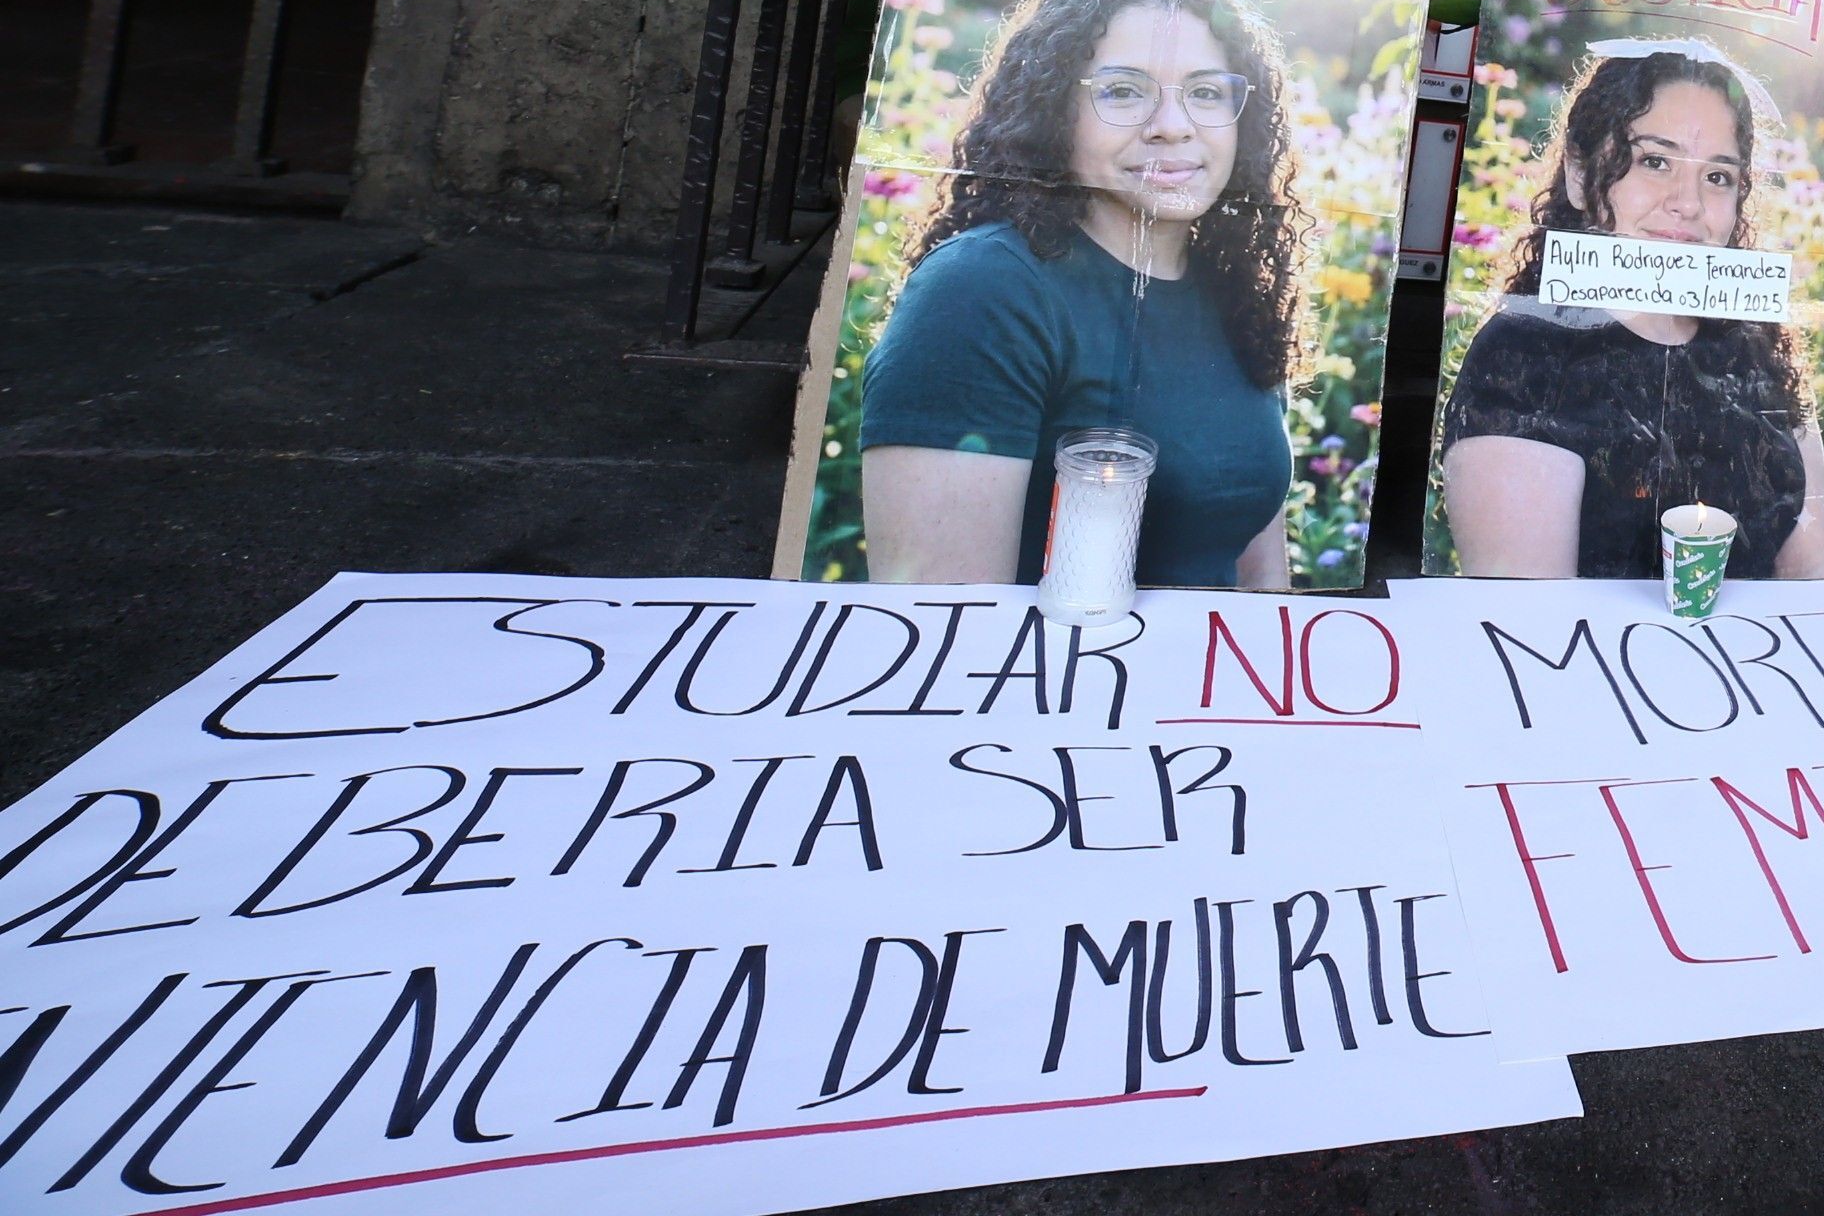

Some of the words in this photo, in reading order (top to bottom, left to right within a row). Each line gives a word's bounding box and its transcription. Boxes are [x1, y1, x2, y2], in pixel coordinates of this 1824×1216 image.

[1546, 278, 1673, 305] Desaparecida
[1549, 238, 1600, 274] Aylin
[1611, 243, 1699, 281] Rodriguez
[1705, 253, 1788, 281] Fernandez
[202, 595, 1146, 740] ESTUDIAR
[1200, 605, 1401, 717] NO
[0, 754, 884, 949] DEBERIA
[949, 743, 1248, 856] SER
[0, 937, 768, 1195] NTENCIA
[797, 927, 1008, 1111] DE
[1040, 884, 1494, 1095] MUERTE
